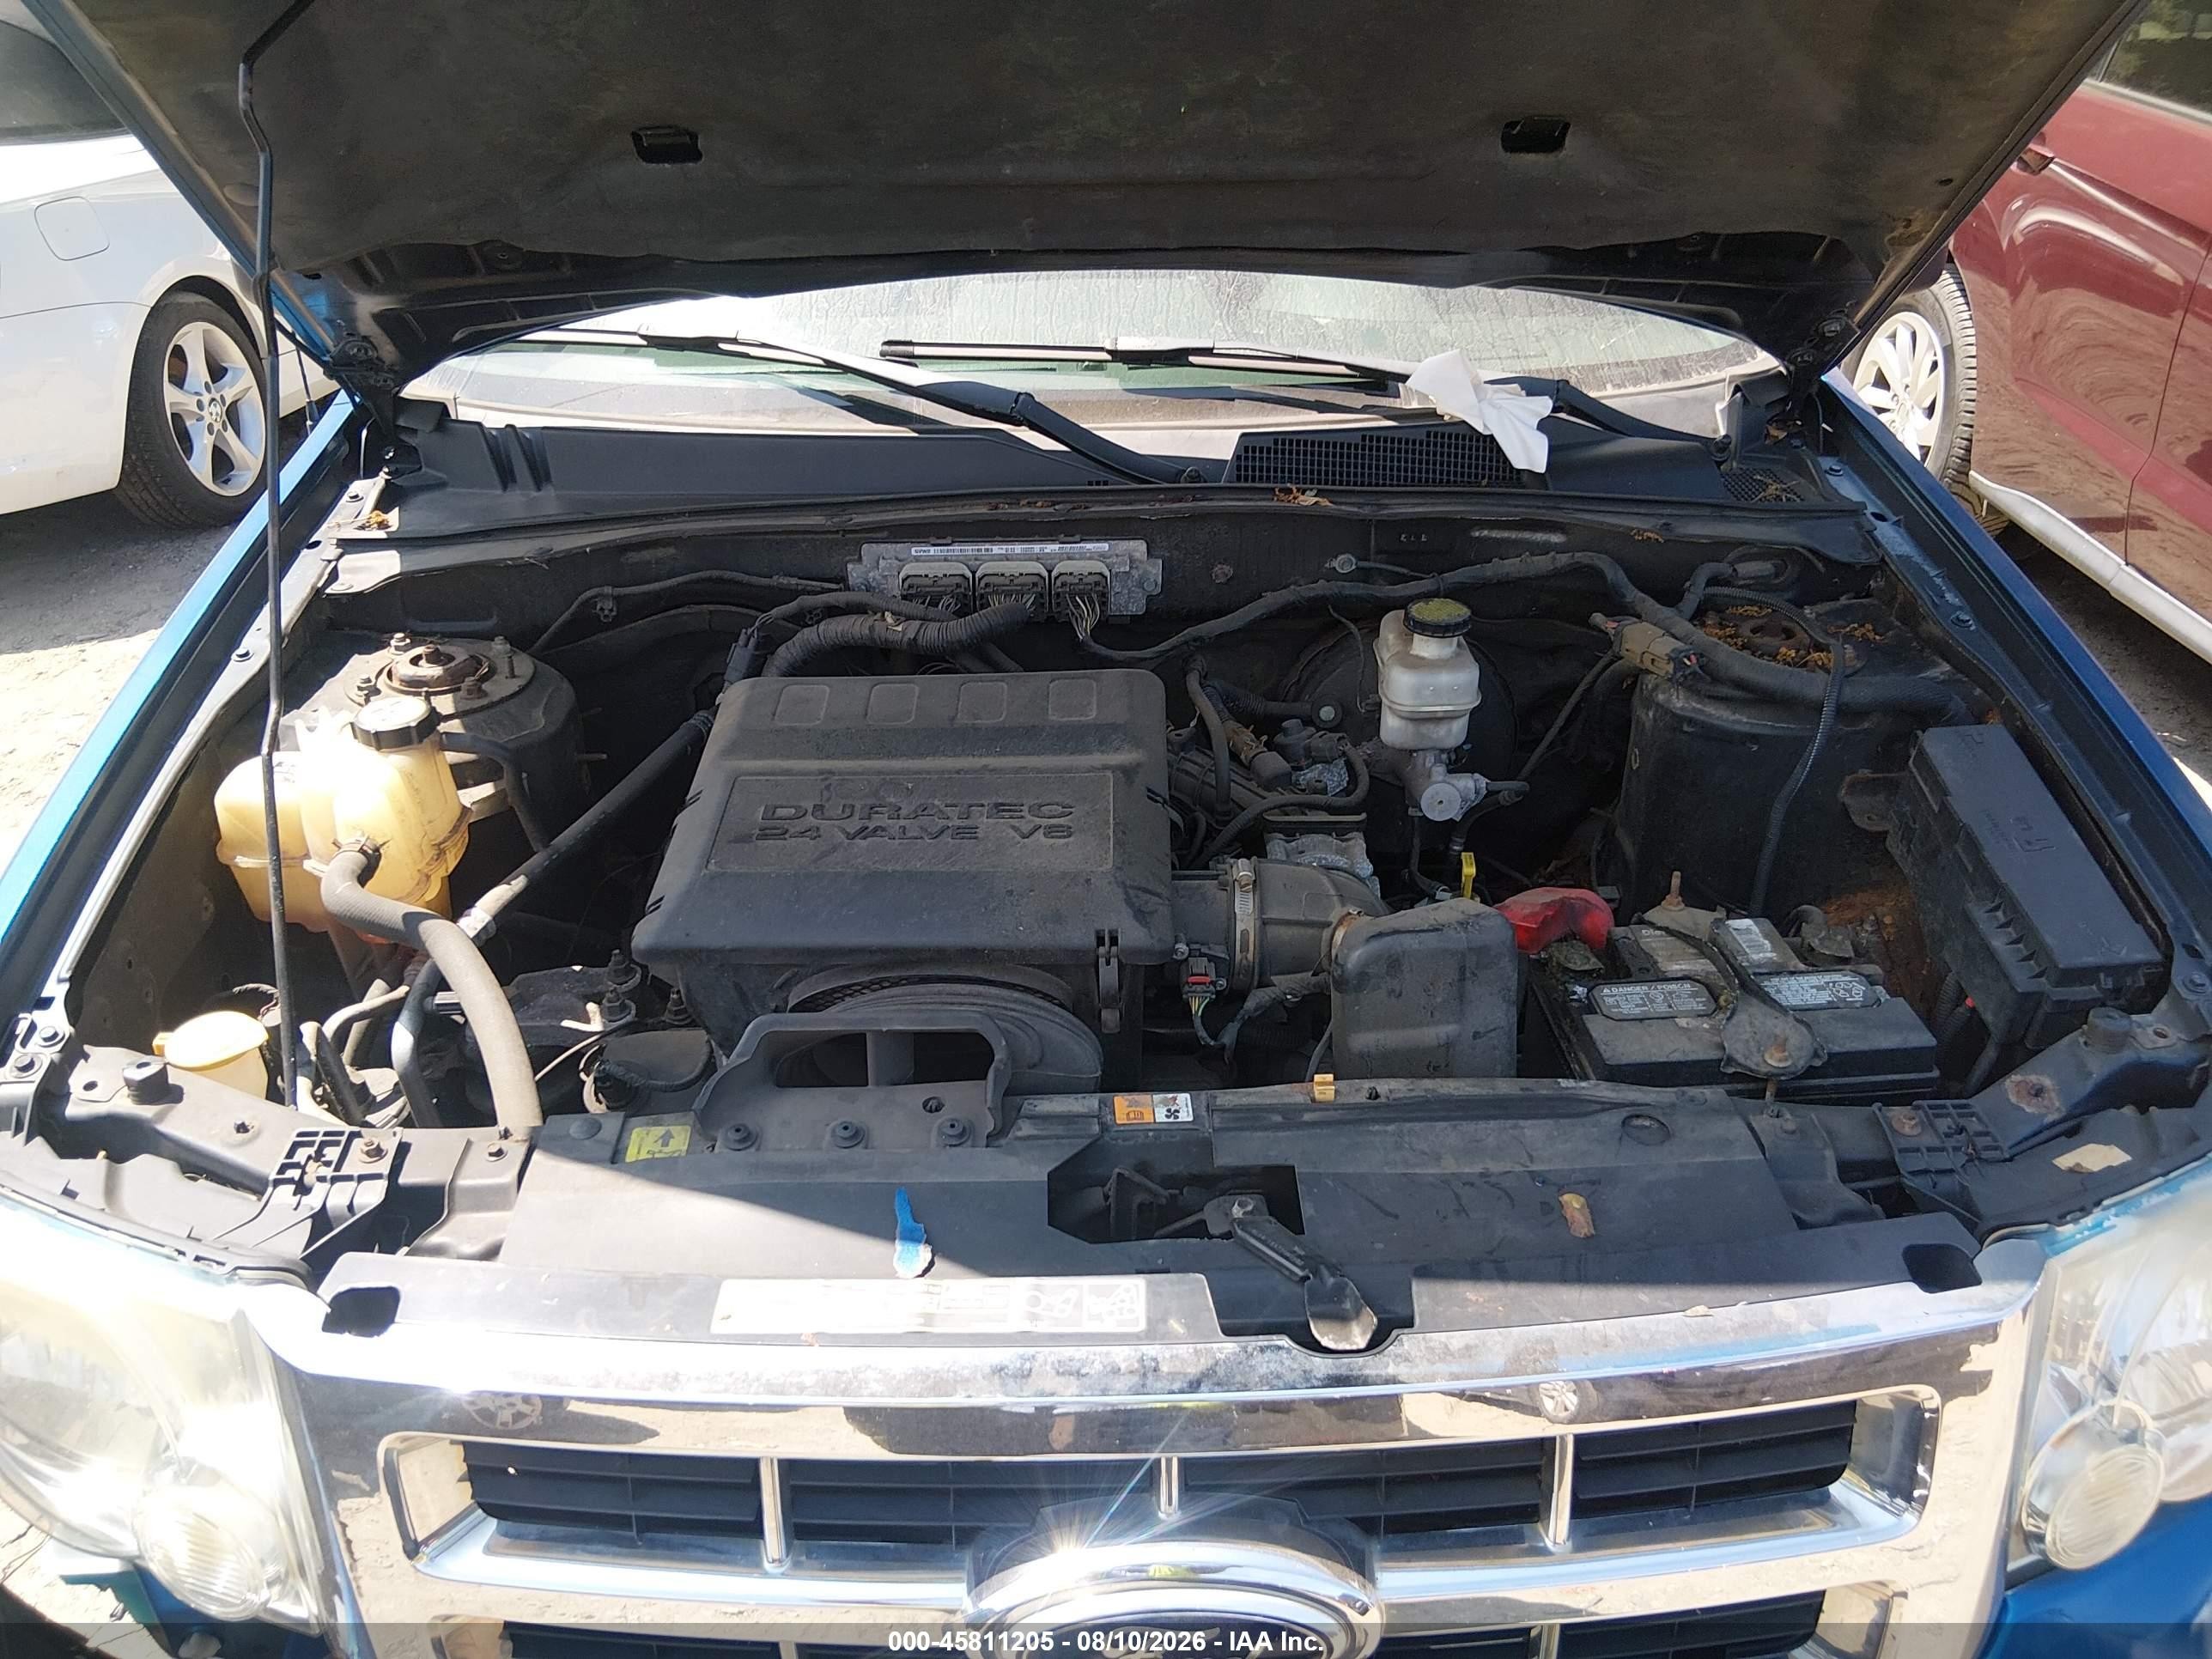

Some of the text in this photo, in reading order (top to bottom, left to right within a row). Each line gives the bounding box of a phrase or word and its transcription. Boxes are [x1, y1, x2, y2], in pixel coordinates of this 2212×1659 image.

[761, 803, 1075, 821] DURATEC
[755, 825, 822, 841] 24
[838, 824, 980, 841] VALVE
[1611, 985, 1650, 994] DANGER
